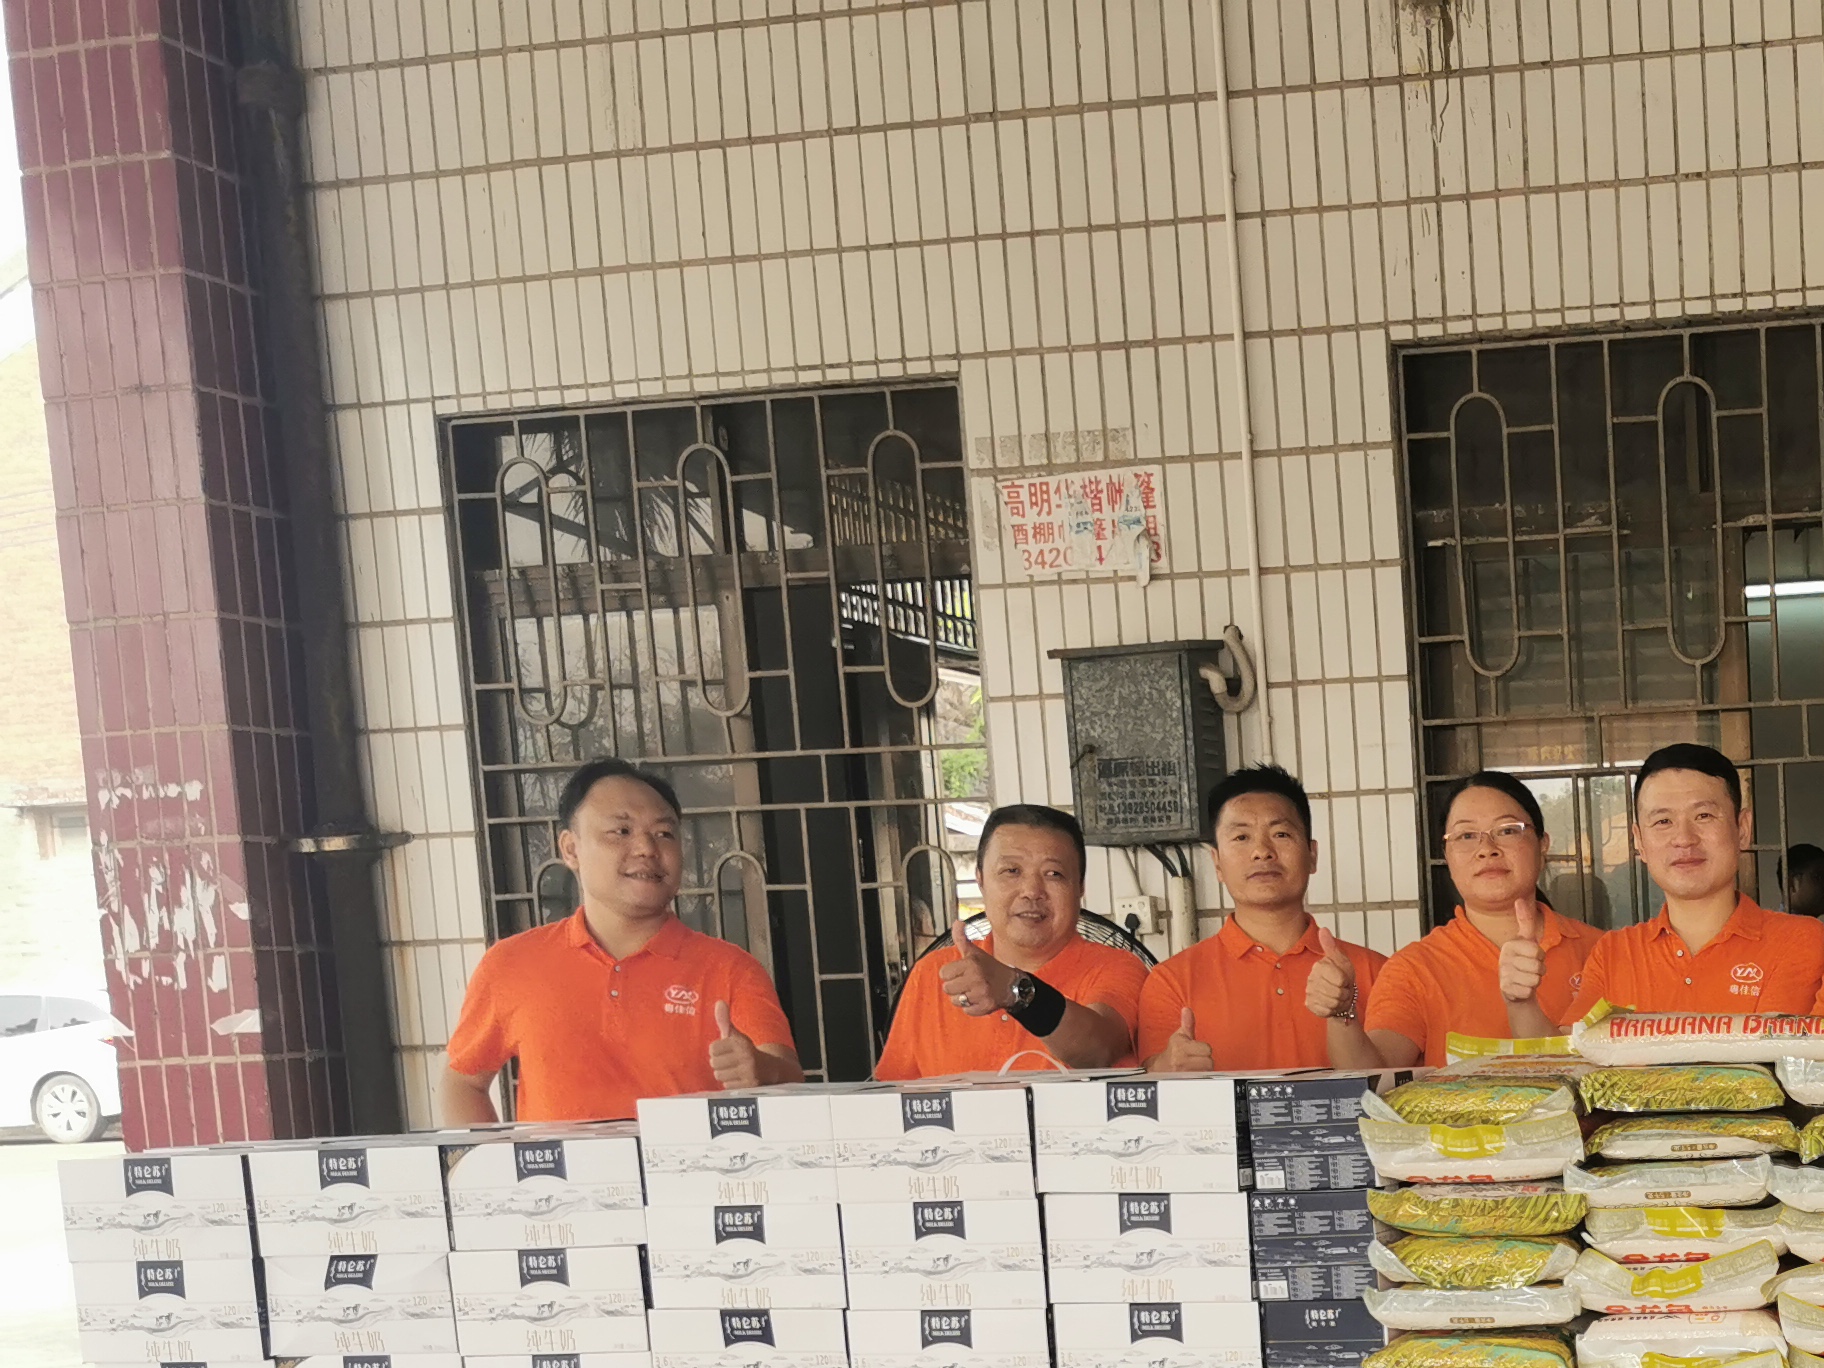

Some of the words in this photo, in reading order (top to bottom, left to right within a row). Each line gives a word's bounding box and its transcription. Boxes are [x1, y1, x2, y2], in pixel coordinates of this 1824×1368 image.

[1609, 1015, 1733, 1038] ARAWANA
[908, 1176, 959, 1199] 纯牛奶
[1110, 1165, 1162, 1188] 纯牛奶
[719, 1181, 768, 1203] 纯牛奶
[328, 1231, 376, 1252] 纯牛奶
[524, 1224, 573, 1246] 纯牛奶
[133, 1238, 181, 1260] 纯牛奶
[722, 1287, 770, 1308] 纯牛奶
[921, 1283, 971, 1305] 纯牛奶
[1123, 1278, 1174, 1301] 纯牛奶
[146, 1340, 192, 1362] 纯牛奶
[335, 1330, 385, 1353] 纯牛奶
[527, 1329, 575, 1351] 纯牛奶
